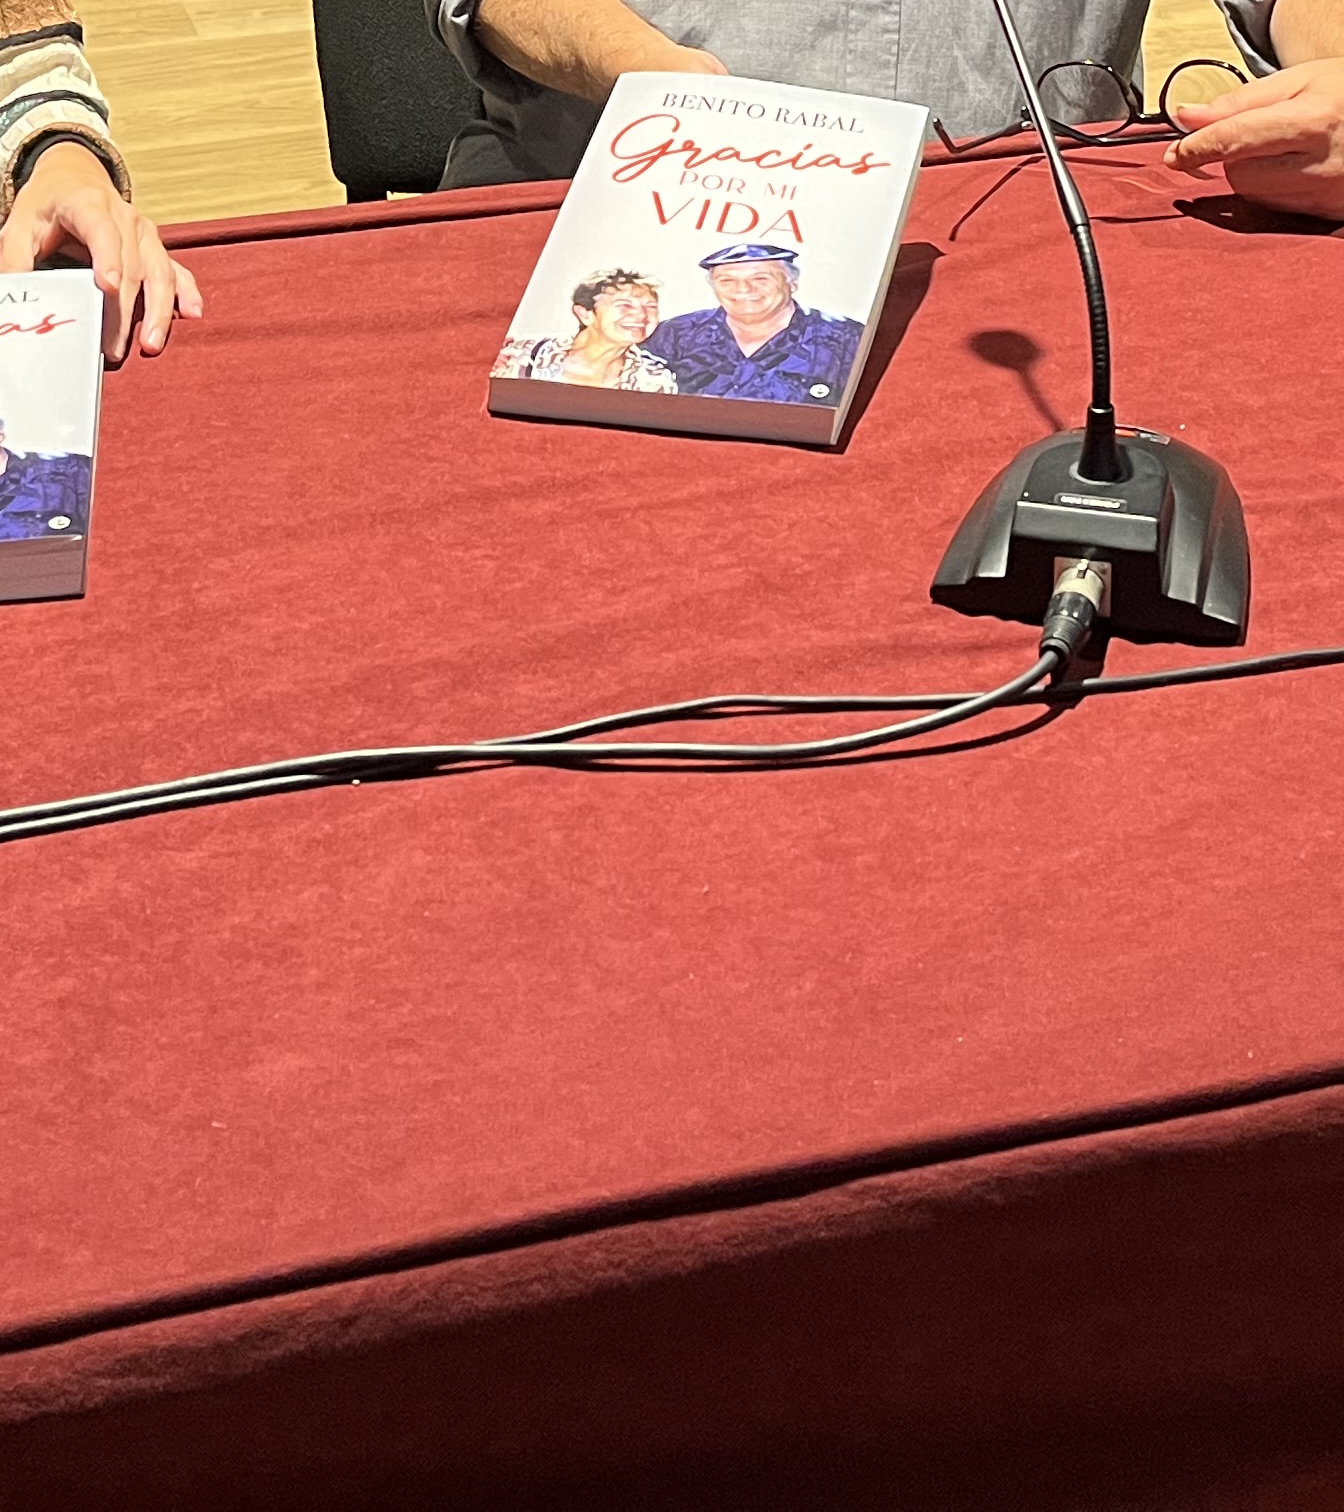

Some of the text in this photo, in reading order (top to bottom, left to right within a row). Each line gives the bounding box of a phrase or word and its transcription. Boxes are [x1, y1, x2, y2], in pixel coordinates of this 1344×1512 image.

[661, 92, 866, 134] BENITO RABAL
[610, 113, 892, 183] Gracias
[679, 170, 798, 201] POR MI
[651, 190, 805, 244] VIDA
